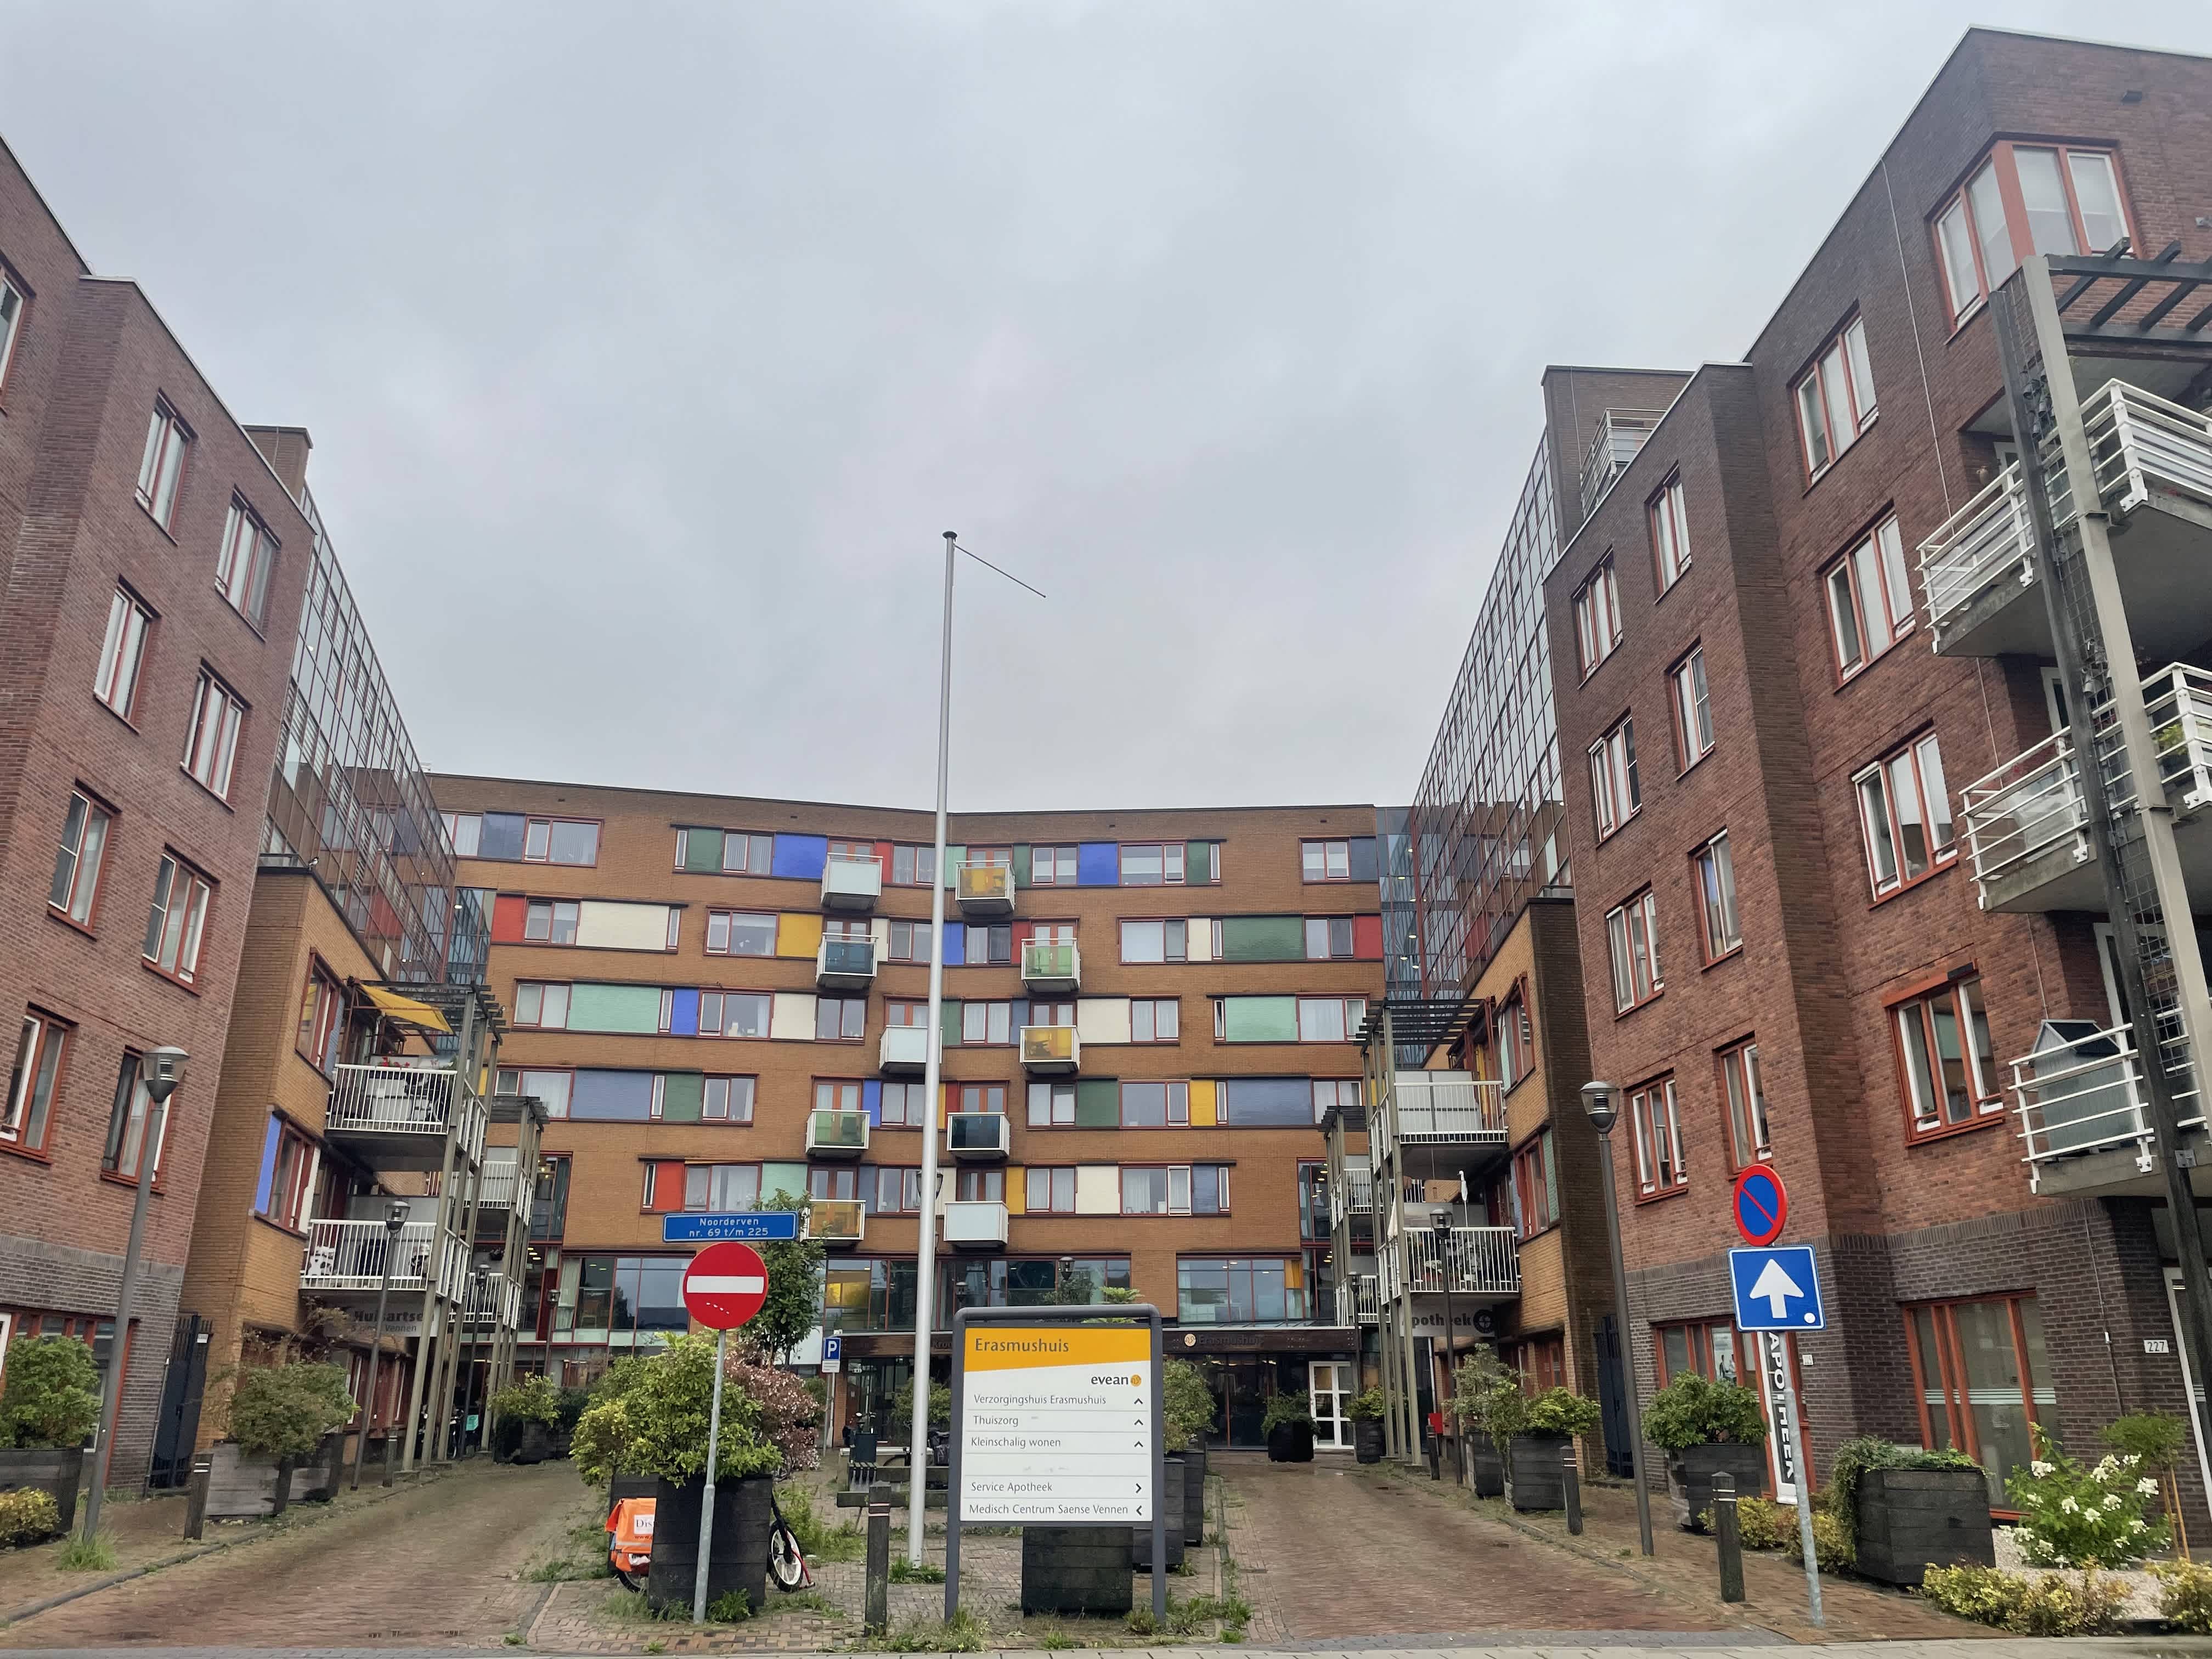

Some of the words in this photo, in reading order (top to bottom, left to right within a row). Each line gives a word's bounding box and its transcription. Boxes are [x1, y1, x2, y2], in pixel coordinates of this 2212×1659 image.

[699, 1217, 759, 1226] Noorderven
[724, 1228, 744, 1236] t/m
[748, 1227, 768, 1235] 225
[1402, 1313, 1471, 1328] pothek
[827, 1340, 838, 1358] P
[975, 1338, 1069, 1352] Erasmushuis
[2147, 1341, 2164, 1352] 227
[1091, 1375, 1128, 1385] evean
[974, 1395, 1047, 1406] Verzorgingshuis
[1050, 1395, 1106, 1405] Erasmushuis
[974, 1415, 1018, 1427] Thuiszorg
[971, 1437, 1026, 1449] Kleinschalig
[1029, 1439, 1061, 1447] wonen
[972, 1482, 1005, 1492] Service
[1007, 1482, 1053, 1493] Apotheek
[969, 1504, 1009, 1514] Medisch
[1013, 1505, 1054, 1514] Centrum
[1058, 1505, 1090, 1514] Saense
[1093, 1505, 1128, 1514] Vennen
